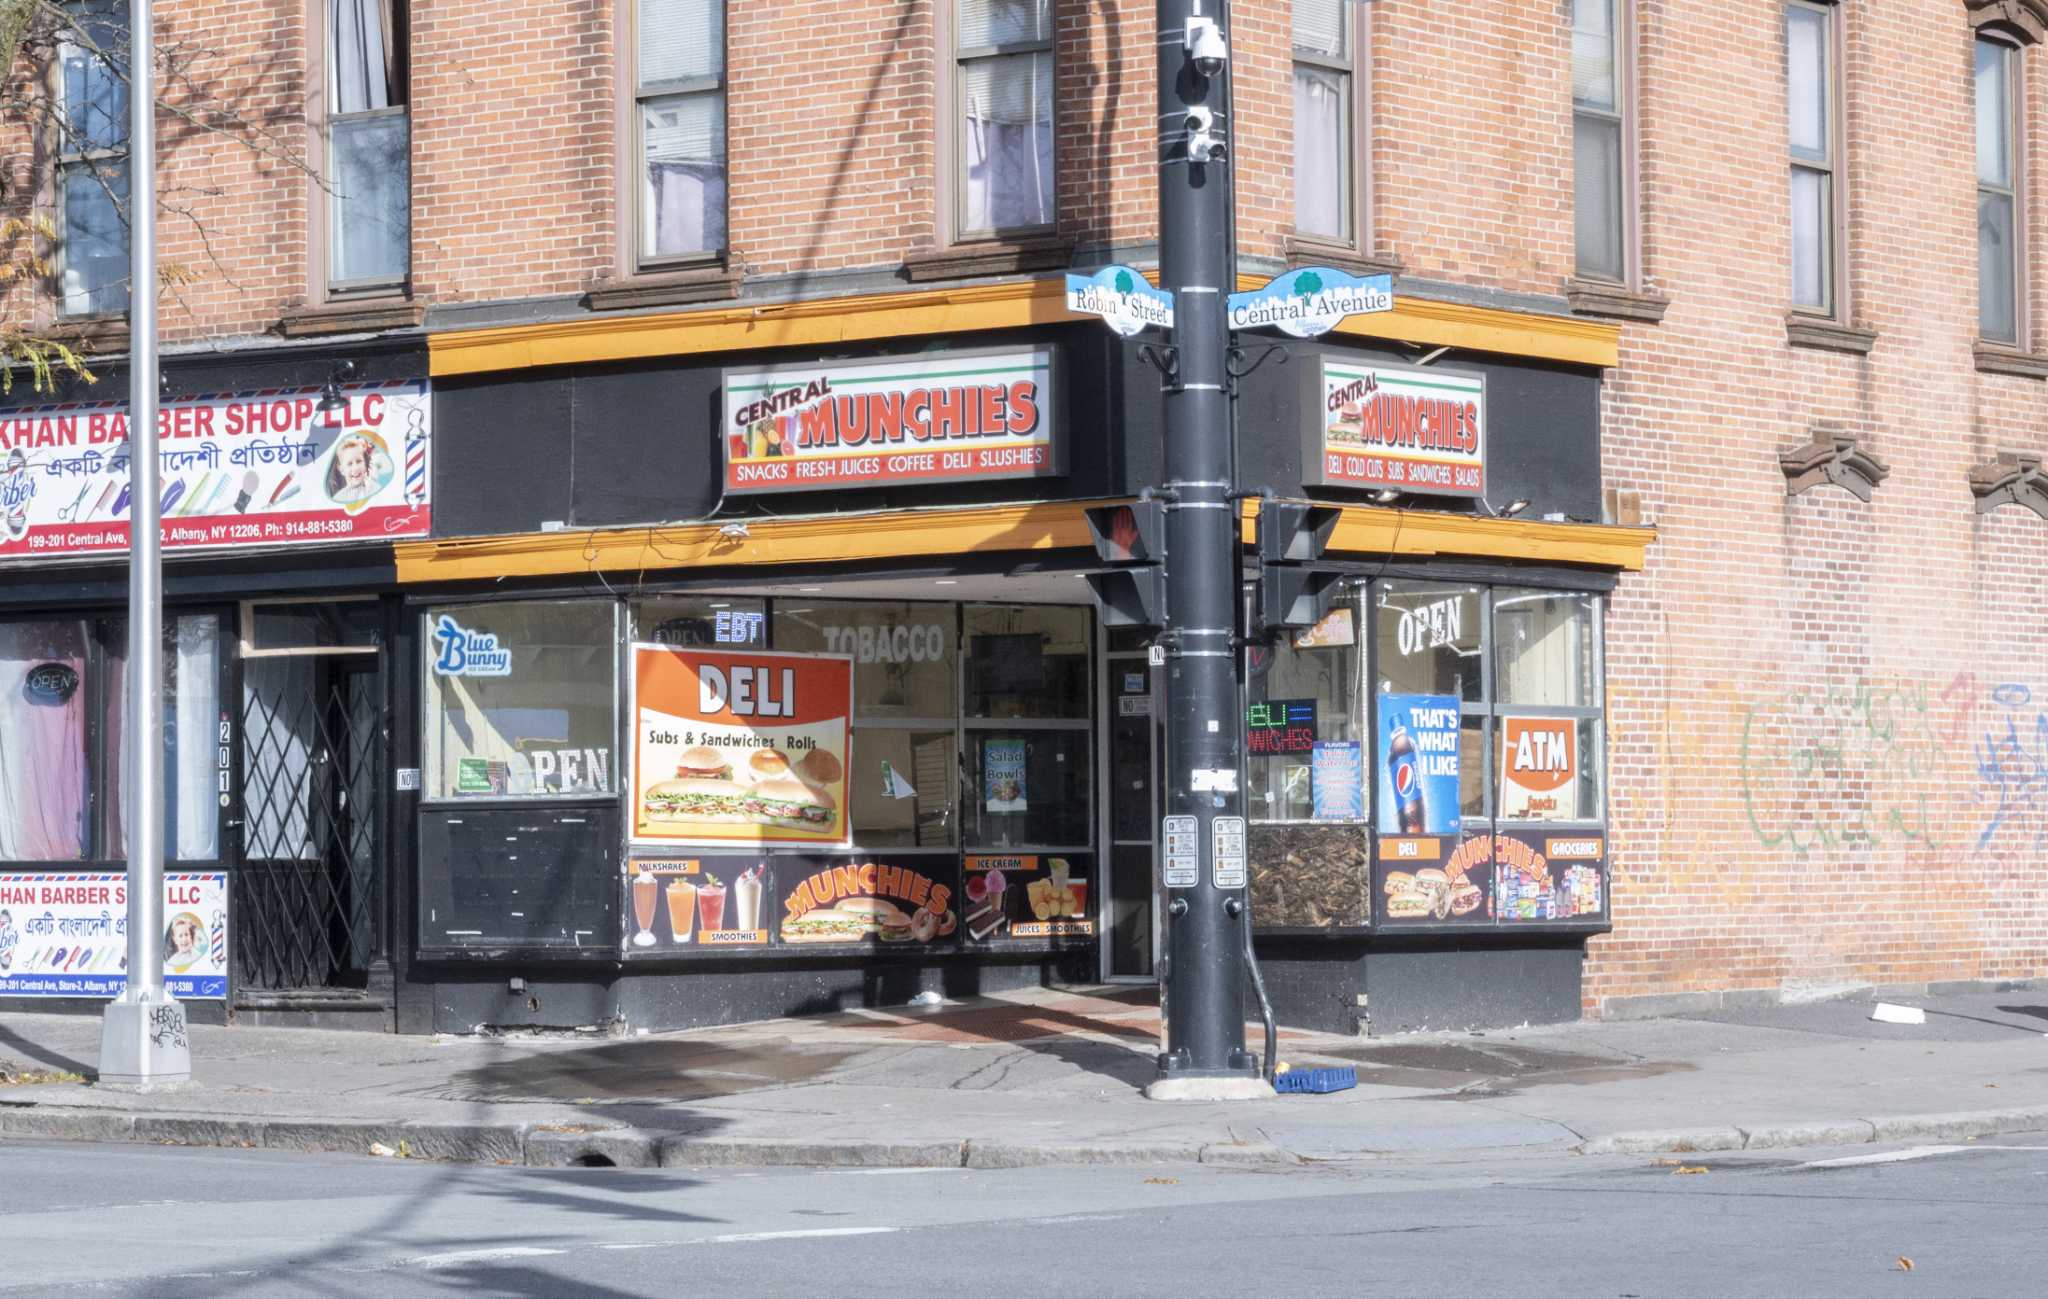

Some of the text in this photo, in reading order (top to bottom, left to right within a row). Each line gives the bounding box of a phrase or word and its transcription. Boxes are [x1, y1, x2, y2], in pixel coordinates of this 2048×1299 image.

[1075, 288, 1168, 323] Robin Street
[1233, 294, 1387, 326] Central Avenue
[735, 376, 832, 427] CENTRAL
[1328, 372, 1378, 412] CENTRAL
[88, 404, 215, 444] BABER
[225, 398, 313, 436] SHOP
[324, 393, 384, 429] LLC
[799, 380, 1039, 448] MUNCHIES
[1361, 391, 1478, 455] MUNCHIES
[46, 449, 103, 478] একটি
[737, 447, 1042, 481] SNACKS FRESH JUICES COFFEE DELI SLUSHIES
[1328, 456, 1479, 487] DELI COLD CUTS SUBS SANDWICHES SALADS
[28, 534, 65, 548] 199-201
[68, 532, 103, 546] Central
[105, 531, 127, 545] Ave,
[171, 526, 208, 542] Albany,
[212, 524, 226, 539] NY
[230, 523, 261, 539] 12206,
[265, 520, 283, 536] Ph:
[716, 611, 763, 643] EBT
[1398, 596, 1462, 656] OPEN
[822, 624, 945, 665] TOBACCO
[32, 673, 71, 689] OPEN
[699, 662, 796, 718] DELI
[1246, 704, 1287, 727] ELI
[1409, 708, 1458, 729] THAT'S
[649, 730, 816, 750] Subs & Sandwiches Rolls
[1248, 728, 1313, 753] WICHES
[1418, 732, 1457, 752] WHAT
[1514, 730, 1569, 772] ATM
[988, 752, 1023, 762] Salad
[1430, 755, 1458, 776] LIKE
[400, 773, 411, 786] NO
[987, 769, 1025, 780] Bowls
[1398, 842, 1417, 857] DELI
[1445, 835, 1548, 884] MUNCHIES
[1551, 842, 1598, 855] GROCERIES
[638, 863, 688, 872] MILKSHAKES
[977, 859, 1022, 869] ICE CREAM
[0, 887, 35, 905] HAN
[41, 886, 110, 905] BARBER
[168, 886, 200, 905] LLC
[783, 863, 952, 921] MUNCHIES
[26, 911, 55, 936] একটি
[1015, 924, 1090, 933] JUICES SMOOTHIES
[711, 932, 757, 942] SMOOTHIES
[20, 979, 44, 991] Central
[108, 980, 118, 991] NY
